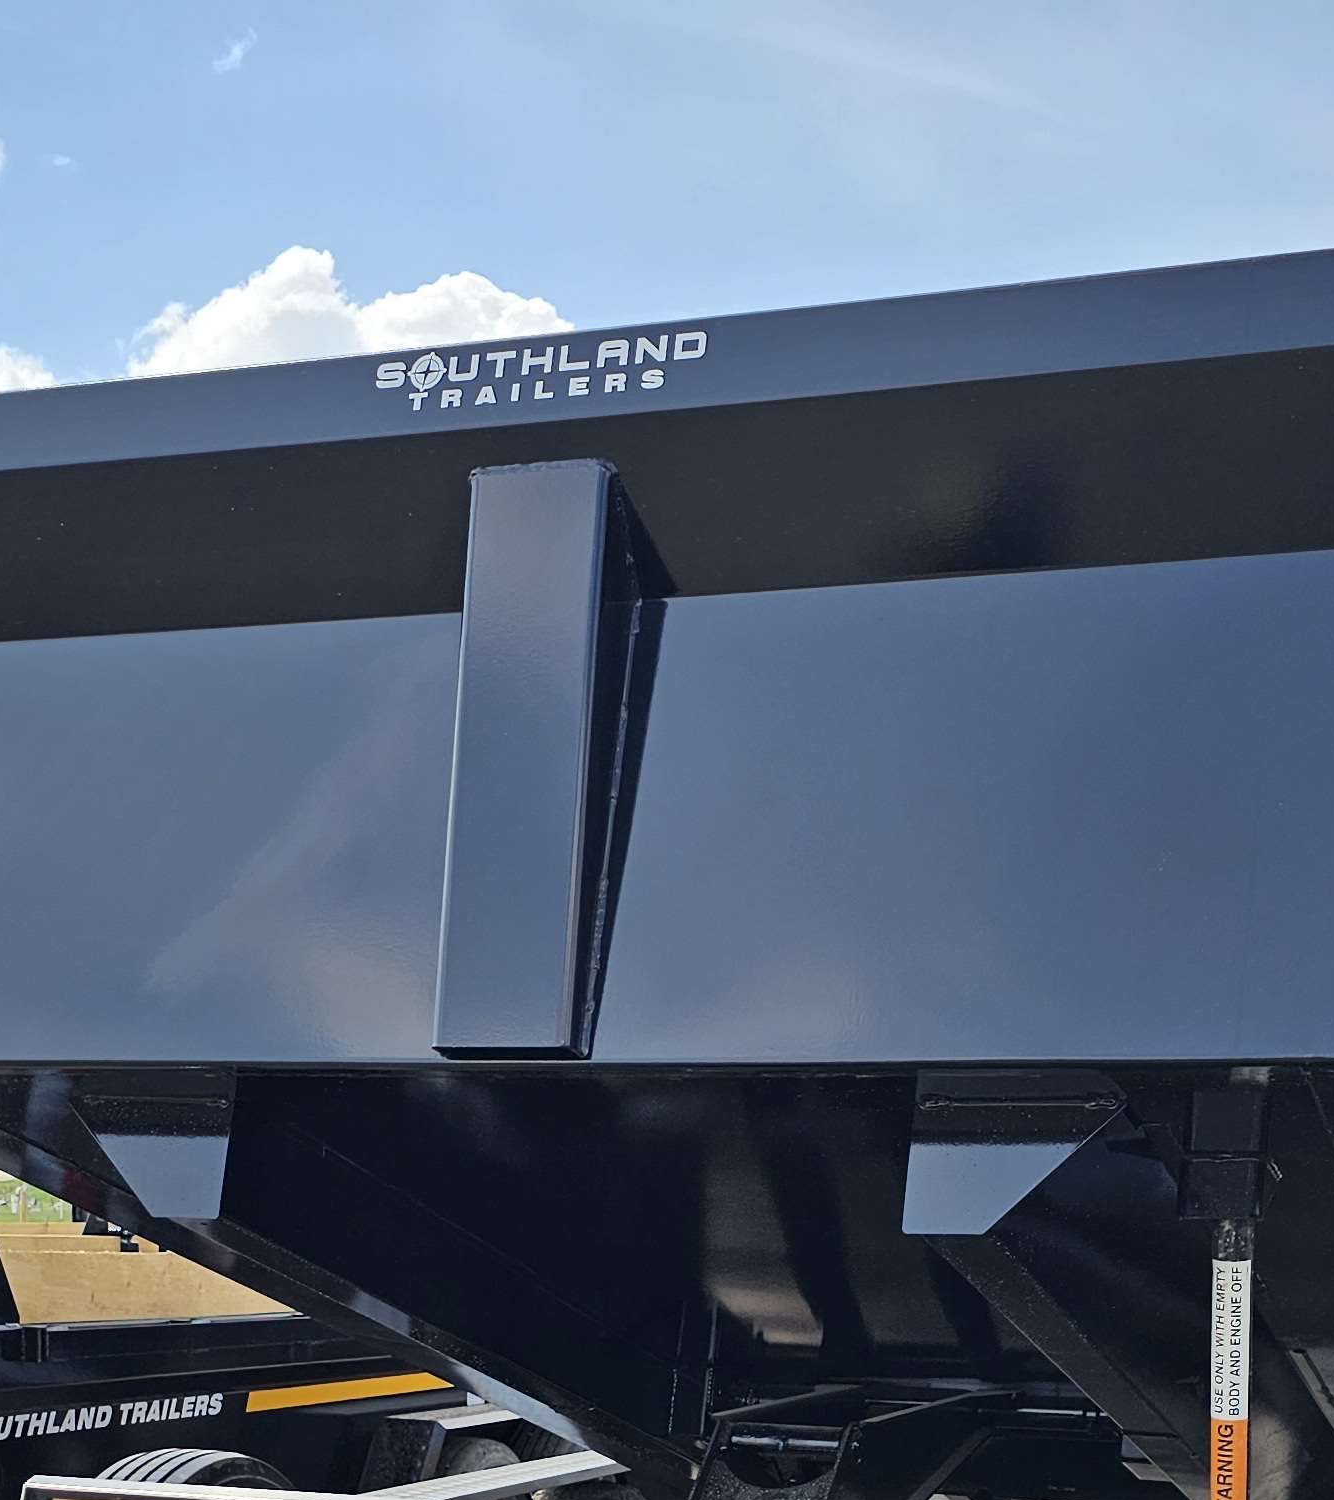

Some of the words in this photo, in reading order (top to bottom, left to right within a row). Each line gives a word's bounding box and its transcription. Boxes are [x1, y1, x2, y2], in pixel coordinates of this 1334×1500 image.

[375, 331, 708, 391] SOUTHLAND
[408, 369, 666, 411] TRAILERS
[1215, 1266, 1225, 1311] EMPTY
[1231, 1266, 1242, 1291] OFF
[1215, 1315, 1225, 1348] WITH
[1230, 1297, 1242, 1346] ENGINE
[1214, 1350, 1224, 1384] ONLY
[1229, 1349, 1241, 1377] AND
[119, 1393, 223, 1425] TRAILERS
[1214, 1389, 1224, 1414] USE
[1228, 1380, 1241, 1416] BODY
